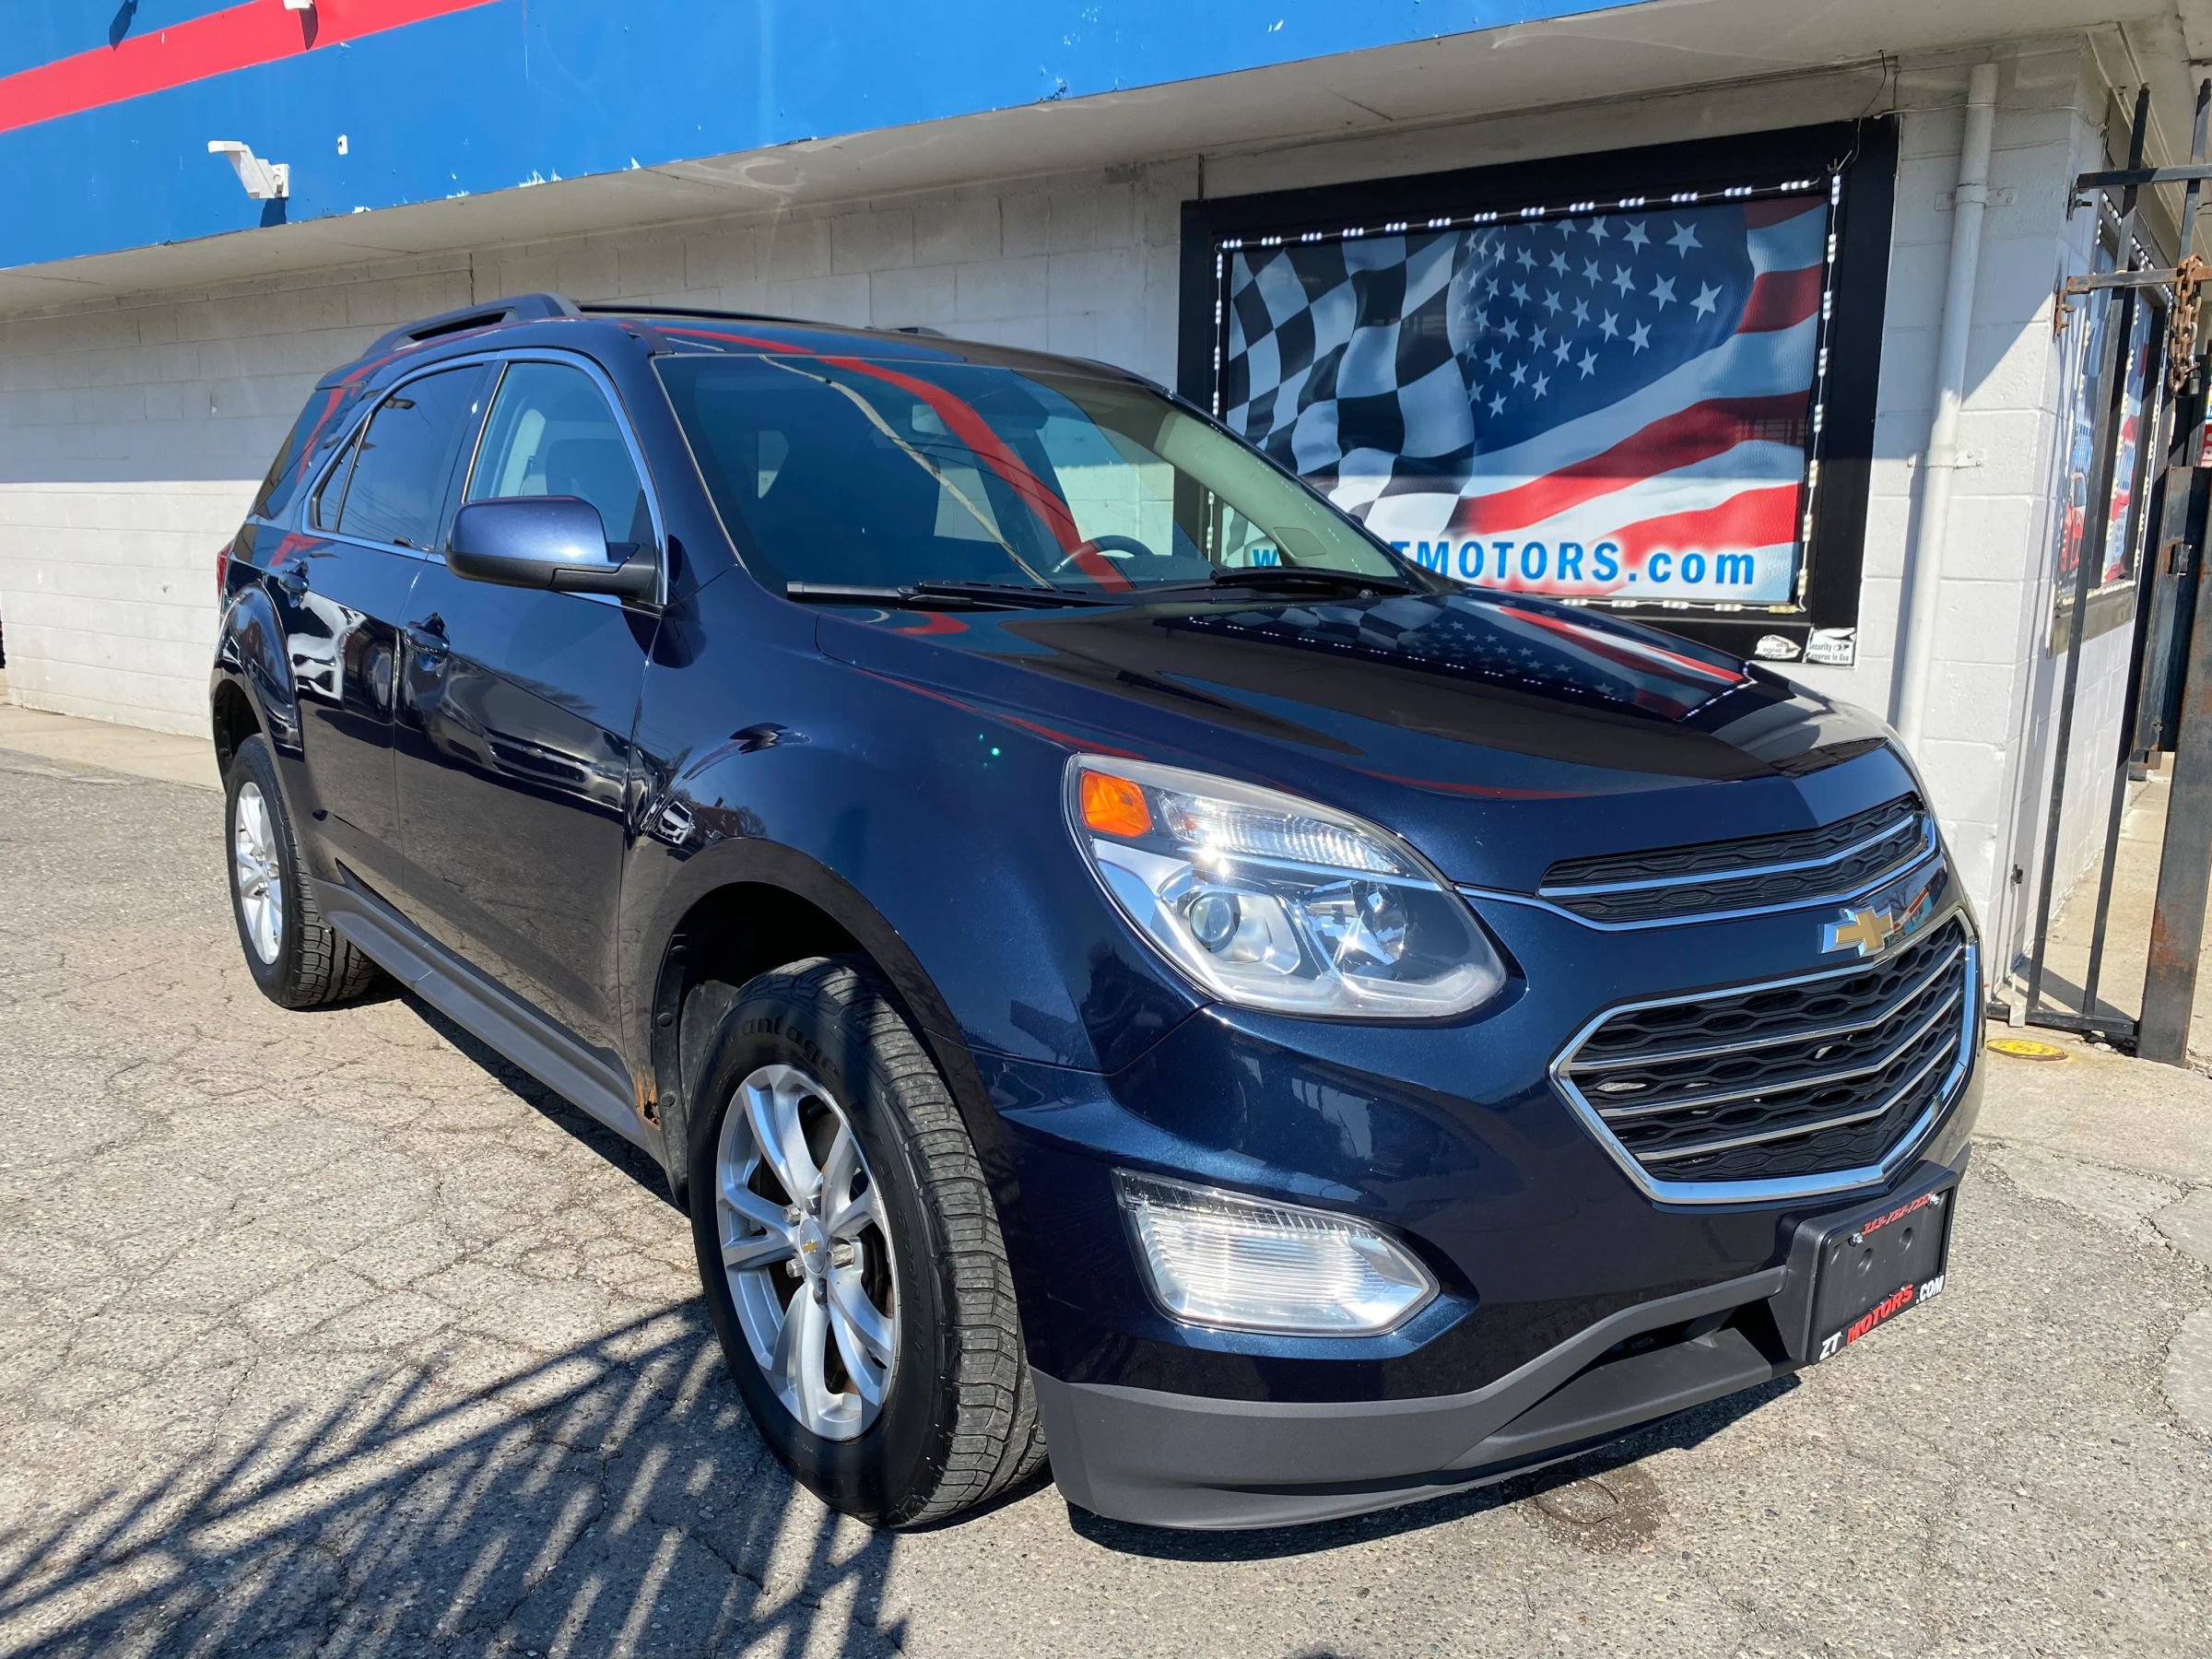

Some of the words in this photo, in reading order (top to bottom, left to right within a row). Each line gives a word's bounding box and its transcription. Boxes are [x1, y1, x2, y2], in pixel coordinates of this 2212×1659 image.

[1806, 653, 1830, 661] ameras
[1819, 1331, 1842, 1360] ZT
[1846, 1284, 1914, 1346] MOTORS
[1916, 1275, 1945, 1304] .COM
